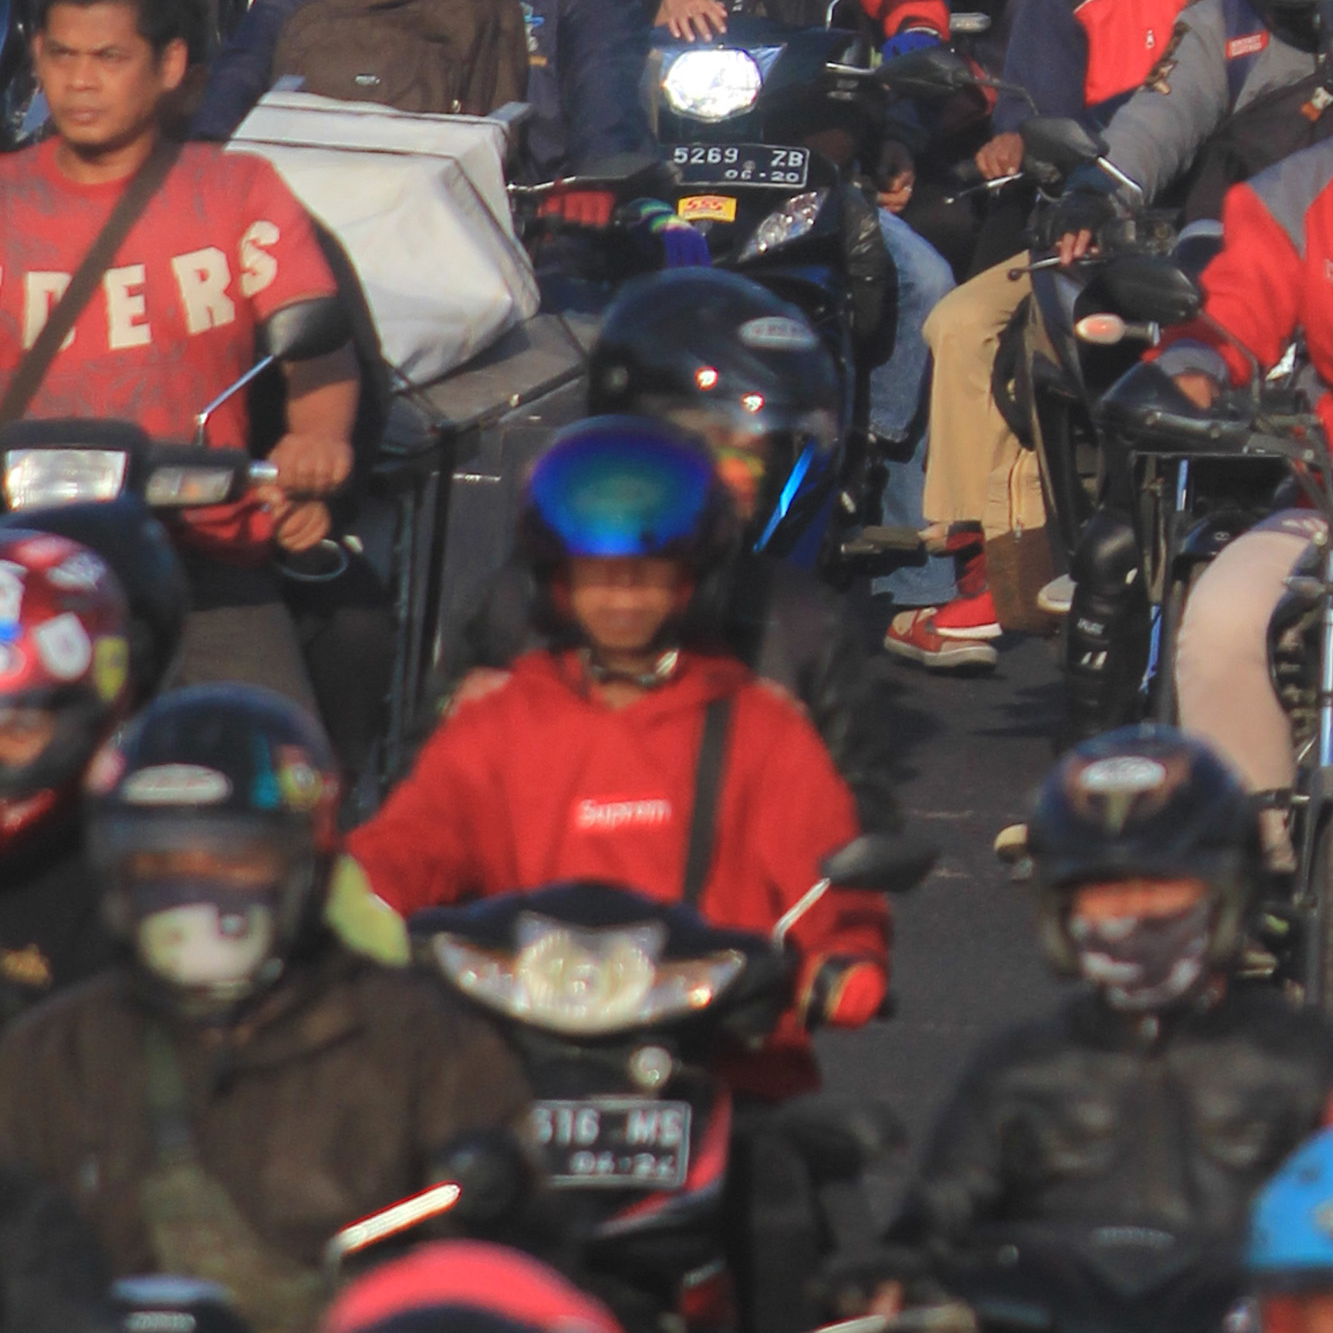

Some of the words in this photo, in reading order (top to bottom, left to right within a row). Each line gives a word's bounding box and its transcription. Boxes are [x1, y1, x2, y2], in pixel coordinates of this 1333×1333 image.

[673, 147, 739, 165] 5269
[770, 151, 805, 168] ZB
[0, 220, 280, 352] DERS
